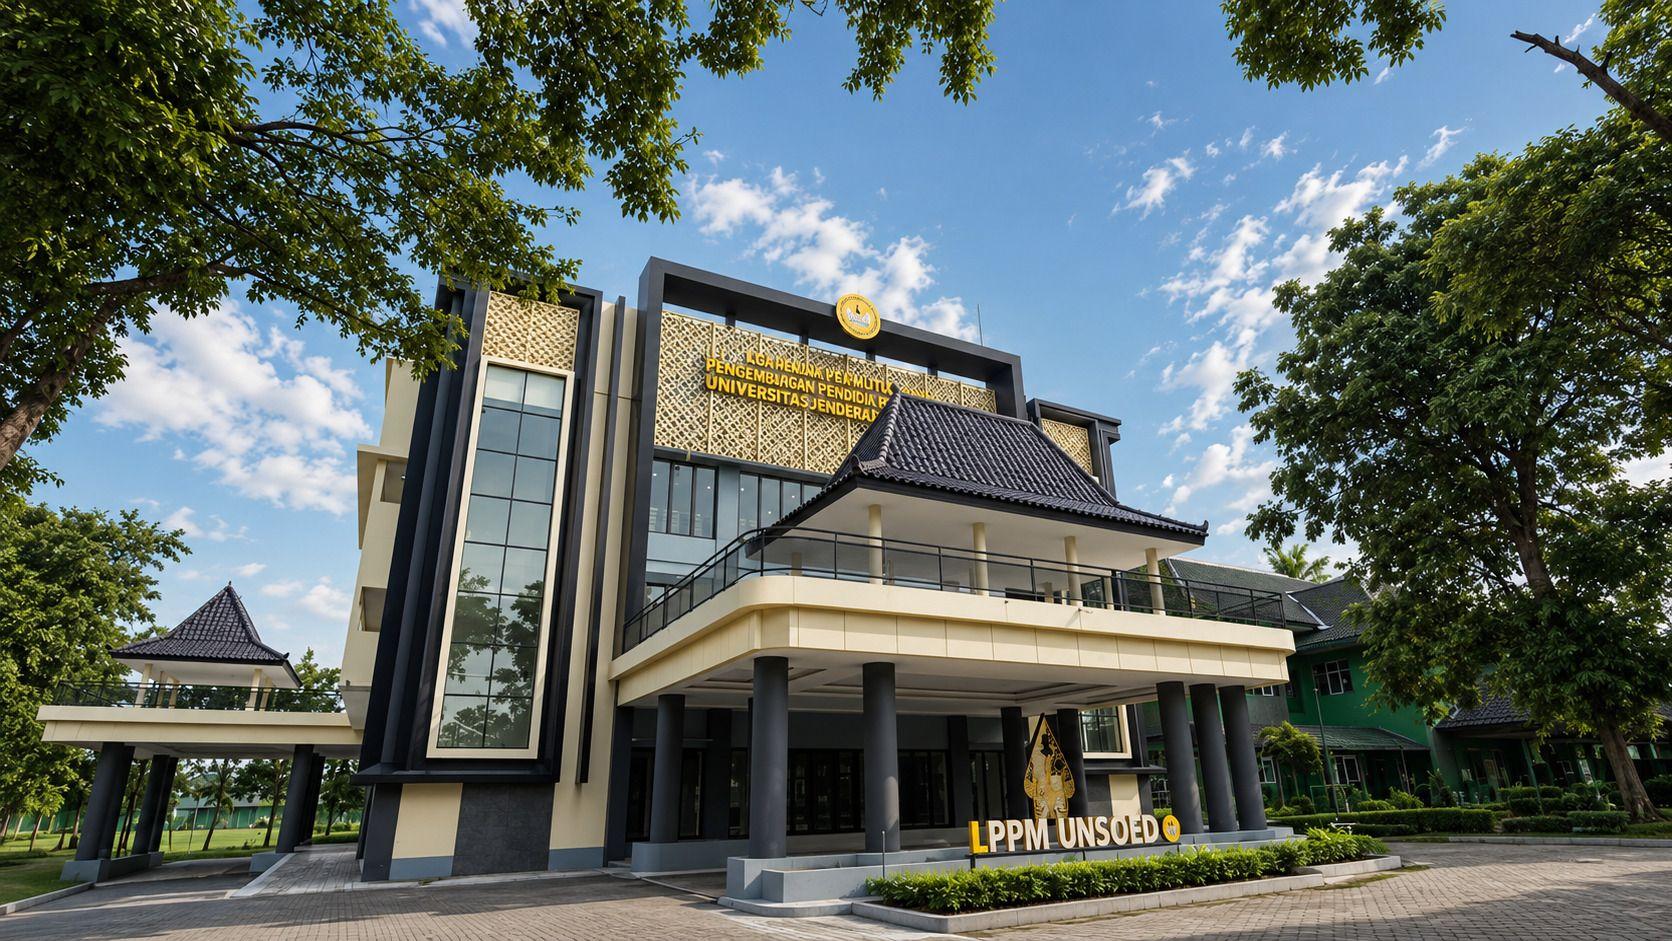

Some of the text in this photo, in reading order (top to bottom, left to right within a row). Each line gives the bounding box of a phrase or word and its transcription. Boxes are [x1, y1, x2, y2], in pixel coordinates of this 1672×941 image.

[705, 374, 809, 408] UNIVERSITAS
[968, 814, 1160, 853] LPPM UNSOED
